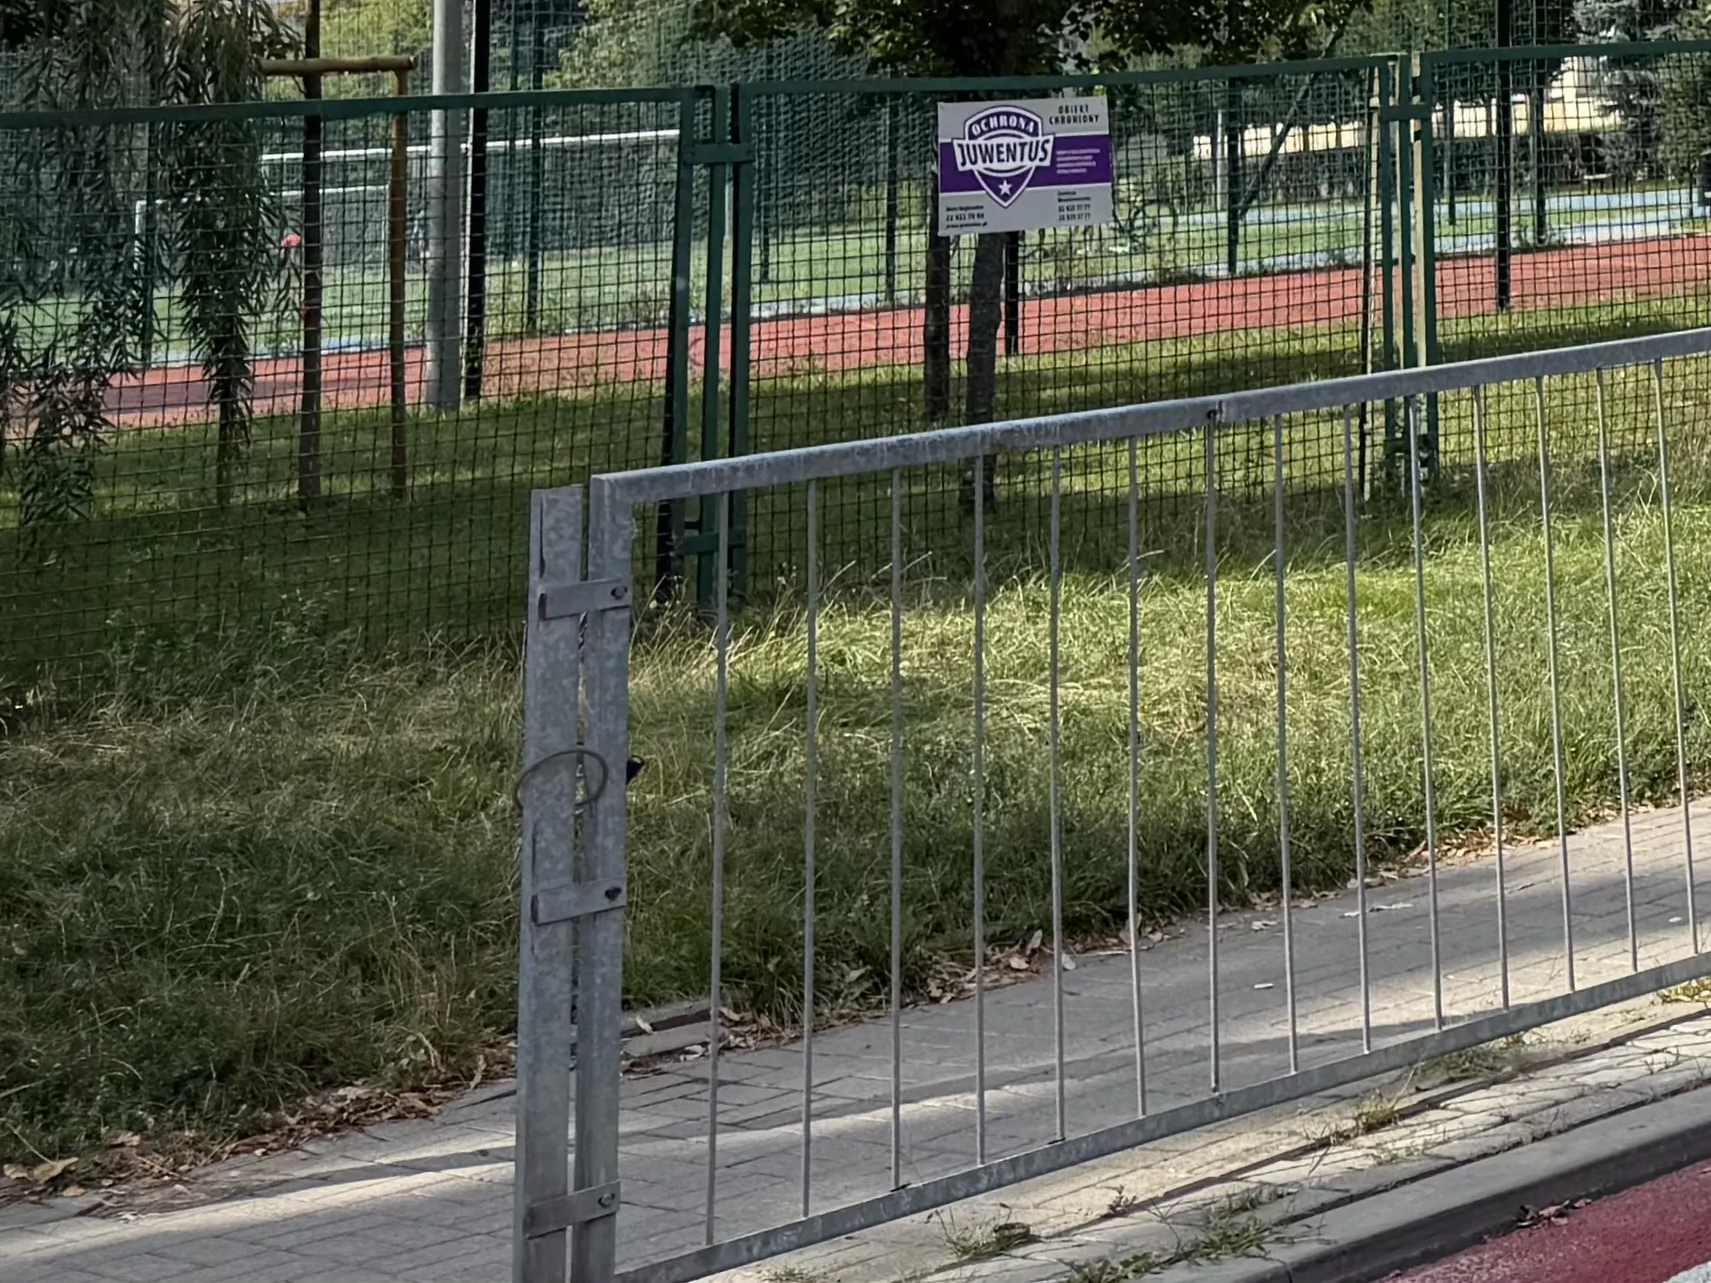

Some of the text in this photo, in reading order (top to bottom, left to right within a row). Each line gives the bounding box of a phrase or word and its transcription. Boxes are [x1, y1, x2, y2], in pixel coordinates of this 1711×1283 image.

[1058, 104, 1089, 114] OBIEKT
[971, 114, 1035, 136] OCHRONA
[1049, 114, 1099, 125] CHRONIONY
[957, 138, 1050, 167] JUWENTUS
